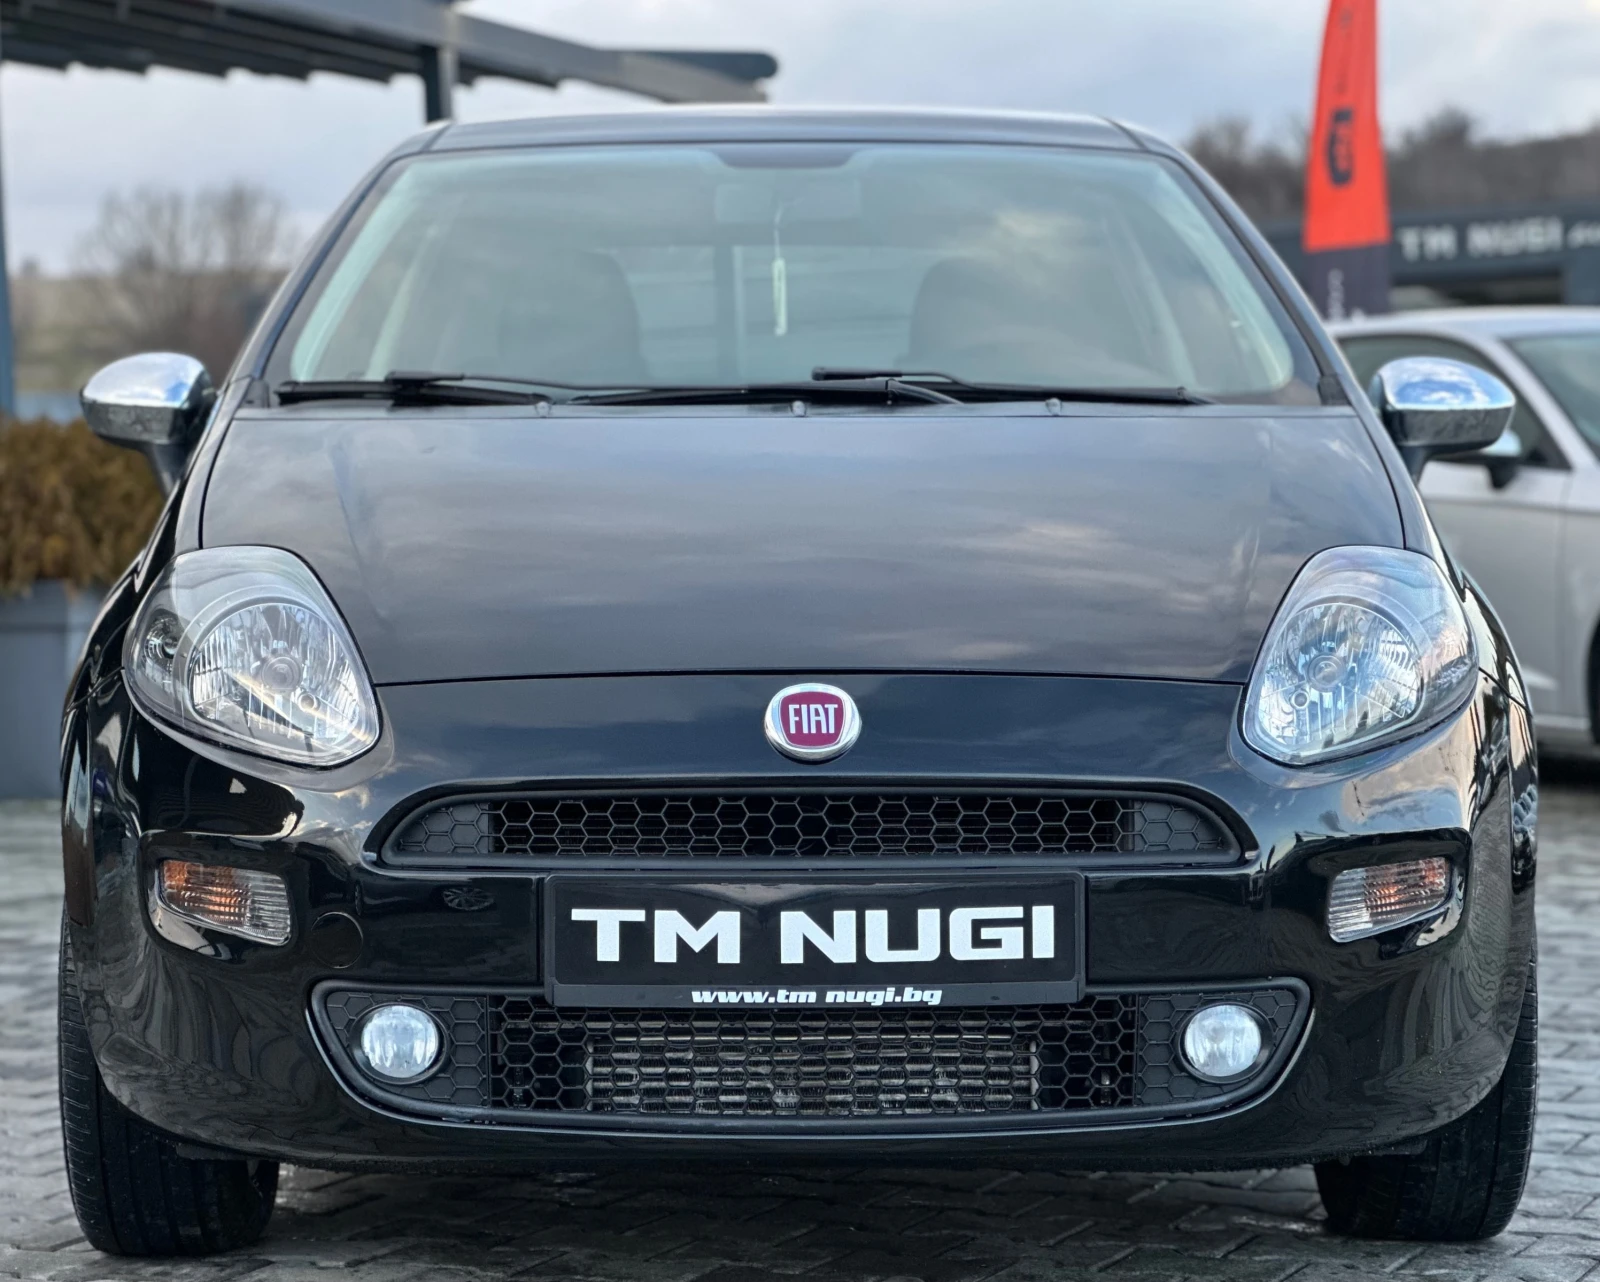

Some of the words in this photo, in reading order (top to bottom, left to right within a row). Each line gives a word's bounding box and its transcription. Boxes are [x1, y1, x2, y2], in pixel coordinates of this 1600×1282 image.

[788, 704, 838, 734] FIAT
[571, 908, 741, 964] TM
[780, 905, 1055, 964] NUGI
